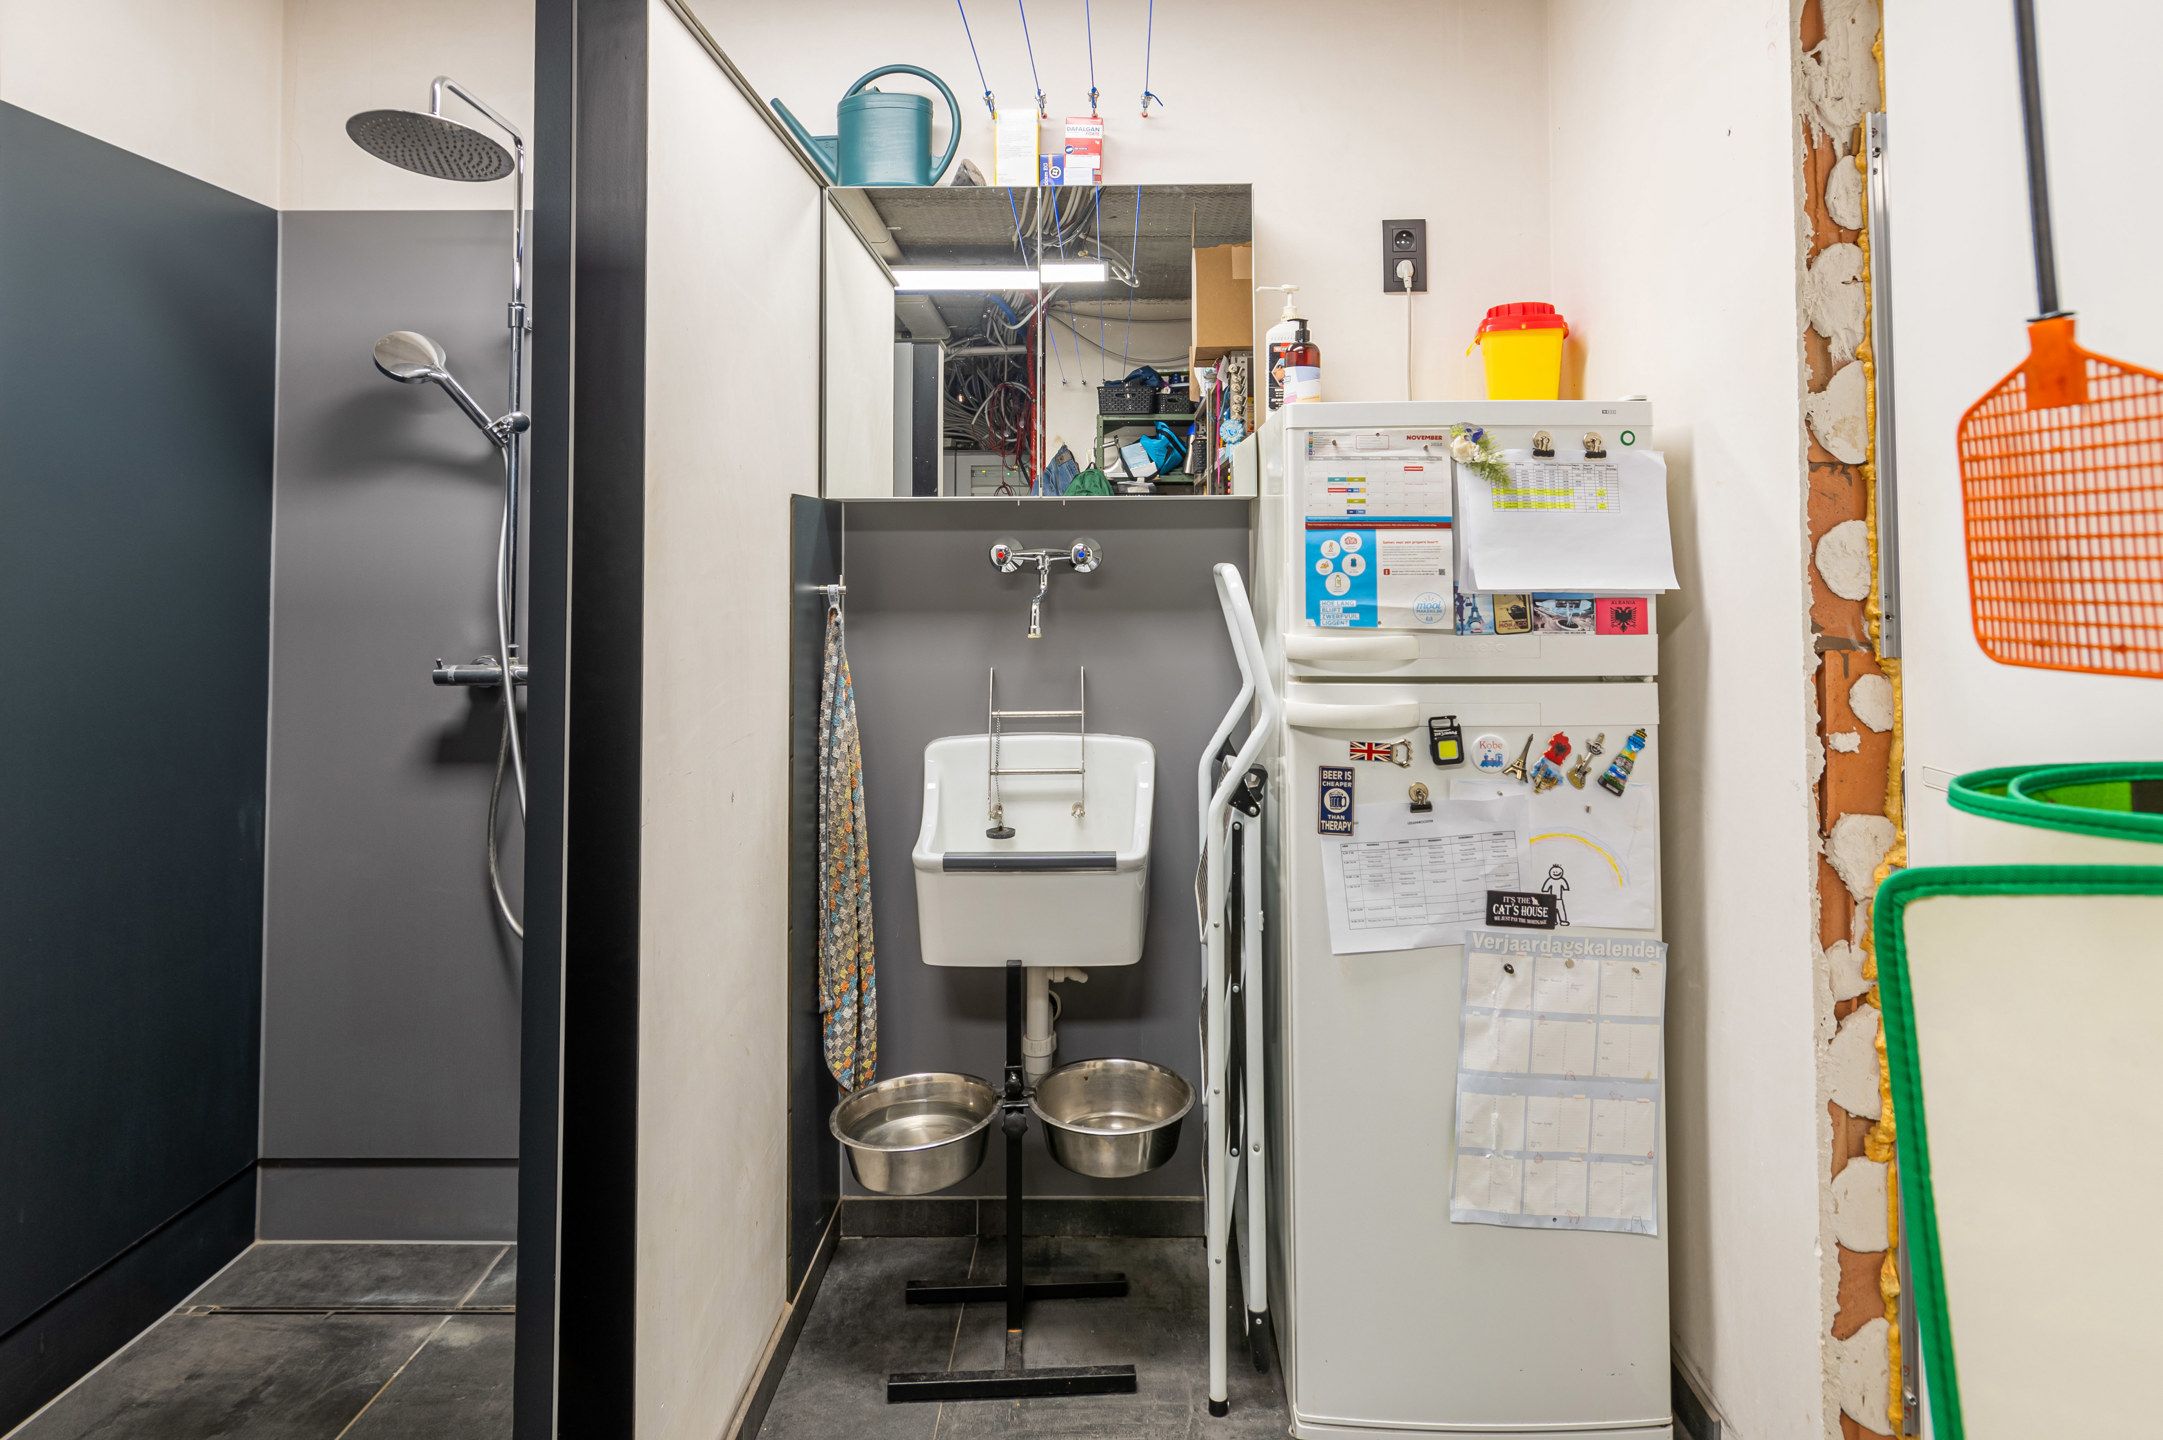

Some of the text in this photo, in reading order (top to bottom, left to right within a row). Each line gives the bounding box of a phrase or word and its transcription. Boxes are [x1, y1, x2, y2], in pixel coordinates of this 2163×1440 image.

[1479, 741, 1503, 749] Kobe
[1322, 770, 1352, 780] BEER IS
[1321, 820, 1352, 831] THERAPY
[1516, 896, 1531, 904] THE
[1492, 902, 1549, 918] CAT'S HOUSE
[1471, 932, 1664, 958] Verjaardagskalender
